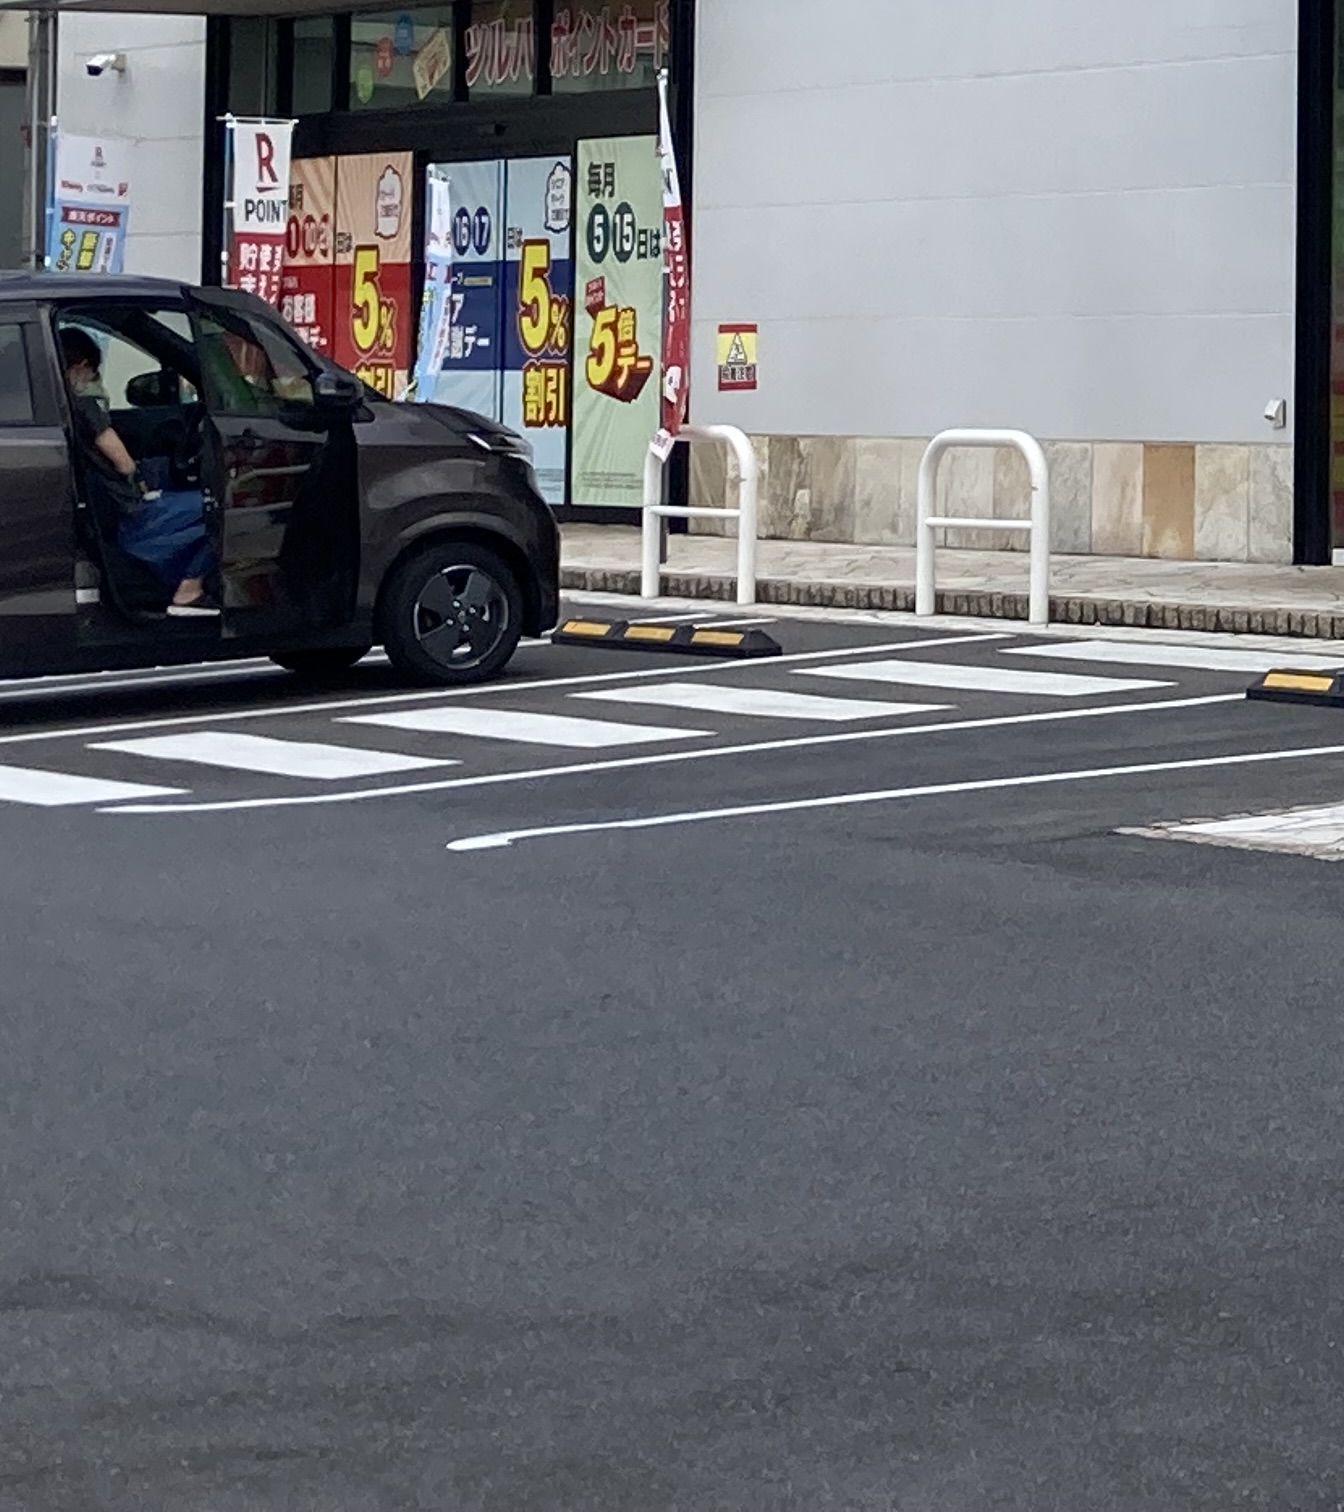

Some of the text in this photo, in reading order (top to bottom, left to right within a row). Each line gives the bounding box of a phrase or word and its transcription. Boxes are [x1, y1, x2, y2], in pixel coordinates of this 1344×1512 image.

[255, 132, 279, 184] R
[587, 161, 616, 198] 毎月
[244, 199, 288, 222] POINT
[474, 215, 489, 247] 17
[592, 213, 604, 253] 5
[614, 213, 633, 253] 15
[525, 367, 565, 422] 割引
